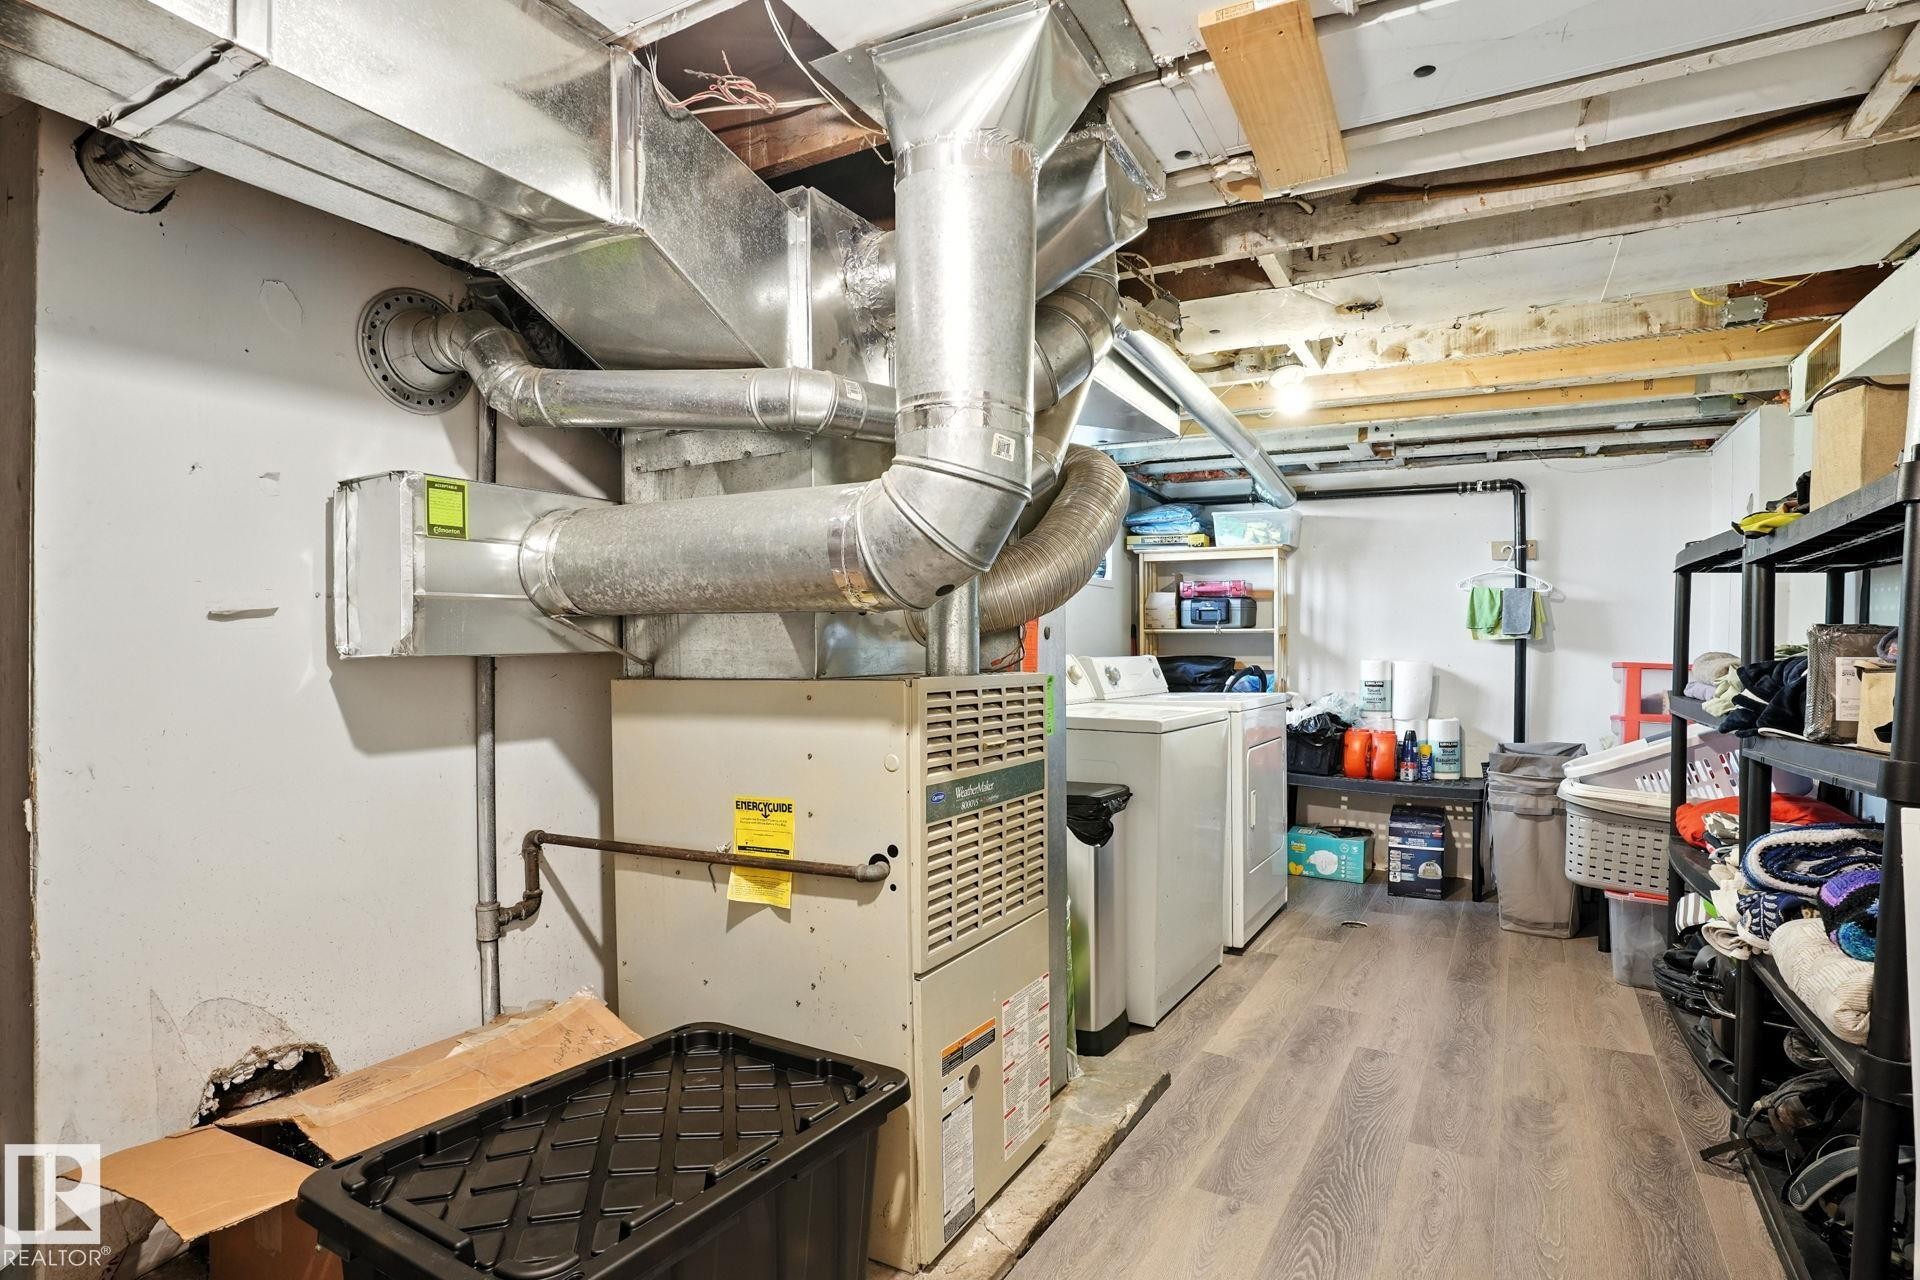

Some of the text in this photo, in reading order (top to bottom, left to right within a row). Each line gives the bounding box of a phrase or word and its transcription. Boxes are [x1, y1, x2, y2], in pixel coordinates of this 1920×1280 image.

[433, 526, 460, 535] Edmonton
[955, 780, 995, 799] WeatherMaker
[735, 800, 793, 814] ENERGYGUIDE
